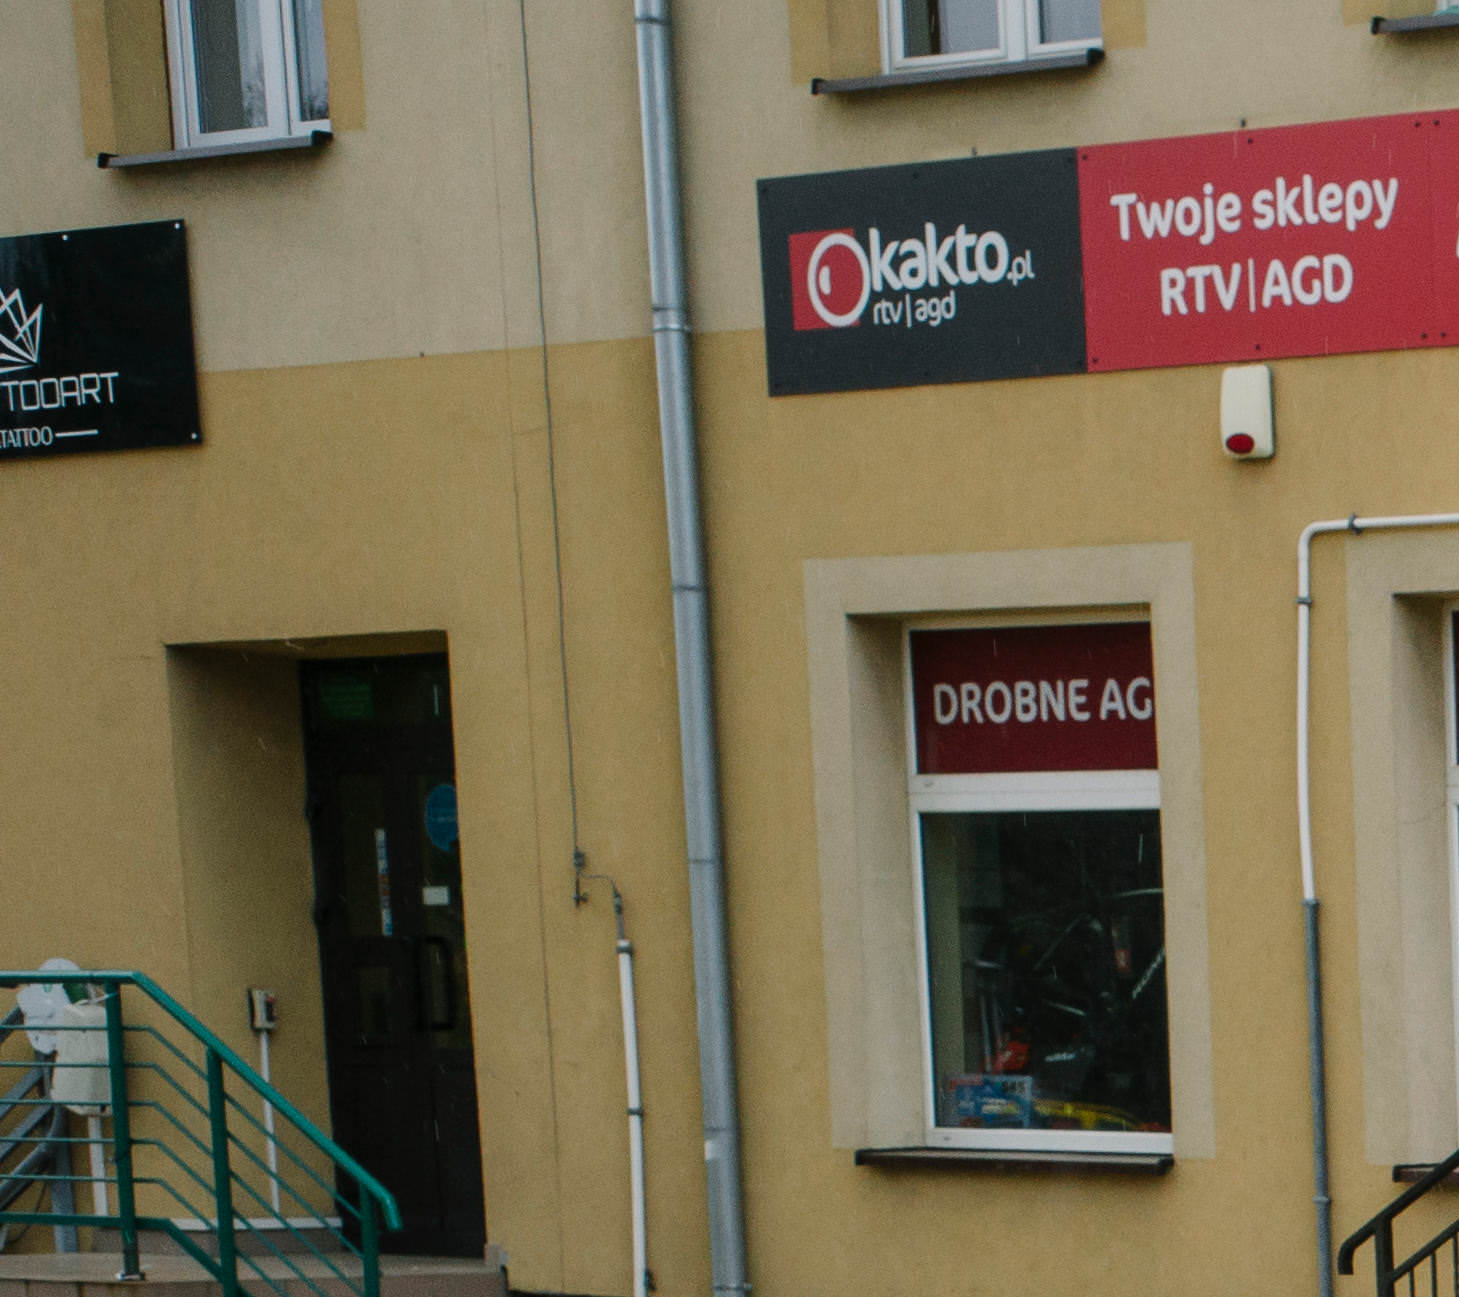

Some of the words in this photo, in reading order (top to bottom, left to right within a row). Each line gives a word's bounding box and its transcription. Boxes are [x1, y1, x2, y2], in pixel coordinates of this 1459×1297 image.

[1110, 182, 1242, 246] Twoje
[1252, 174, 1398, 231] sklepy
[933, 679, 1091, 725] DROBNE
